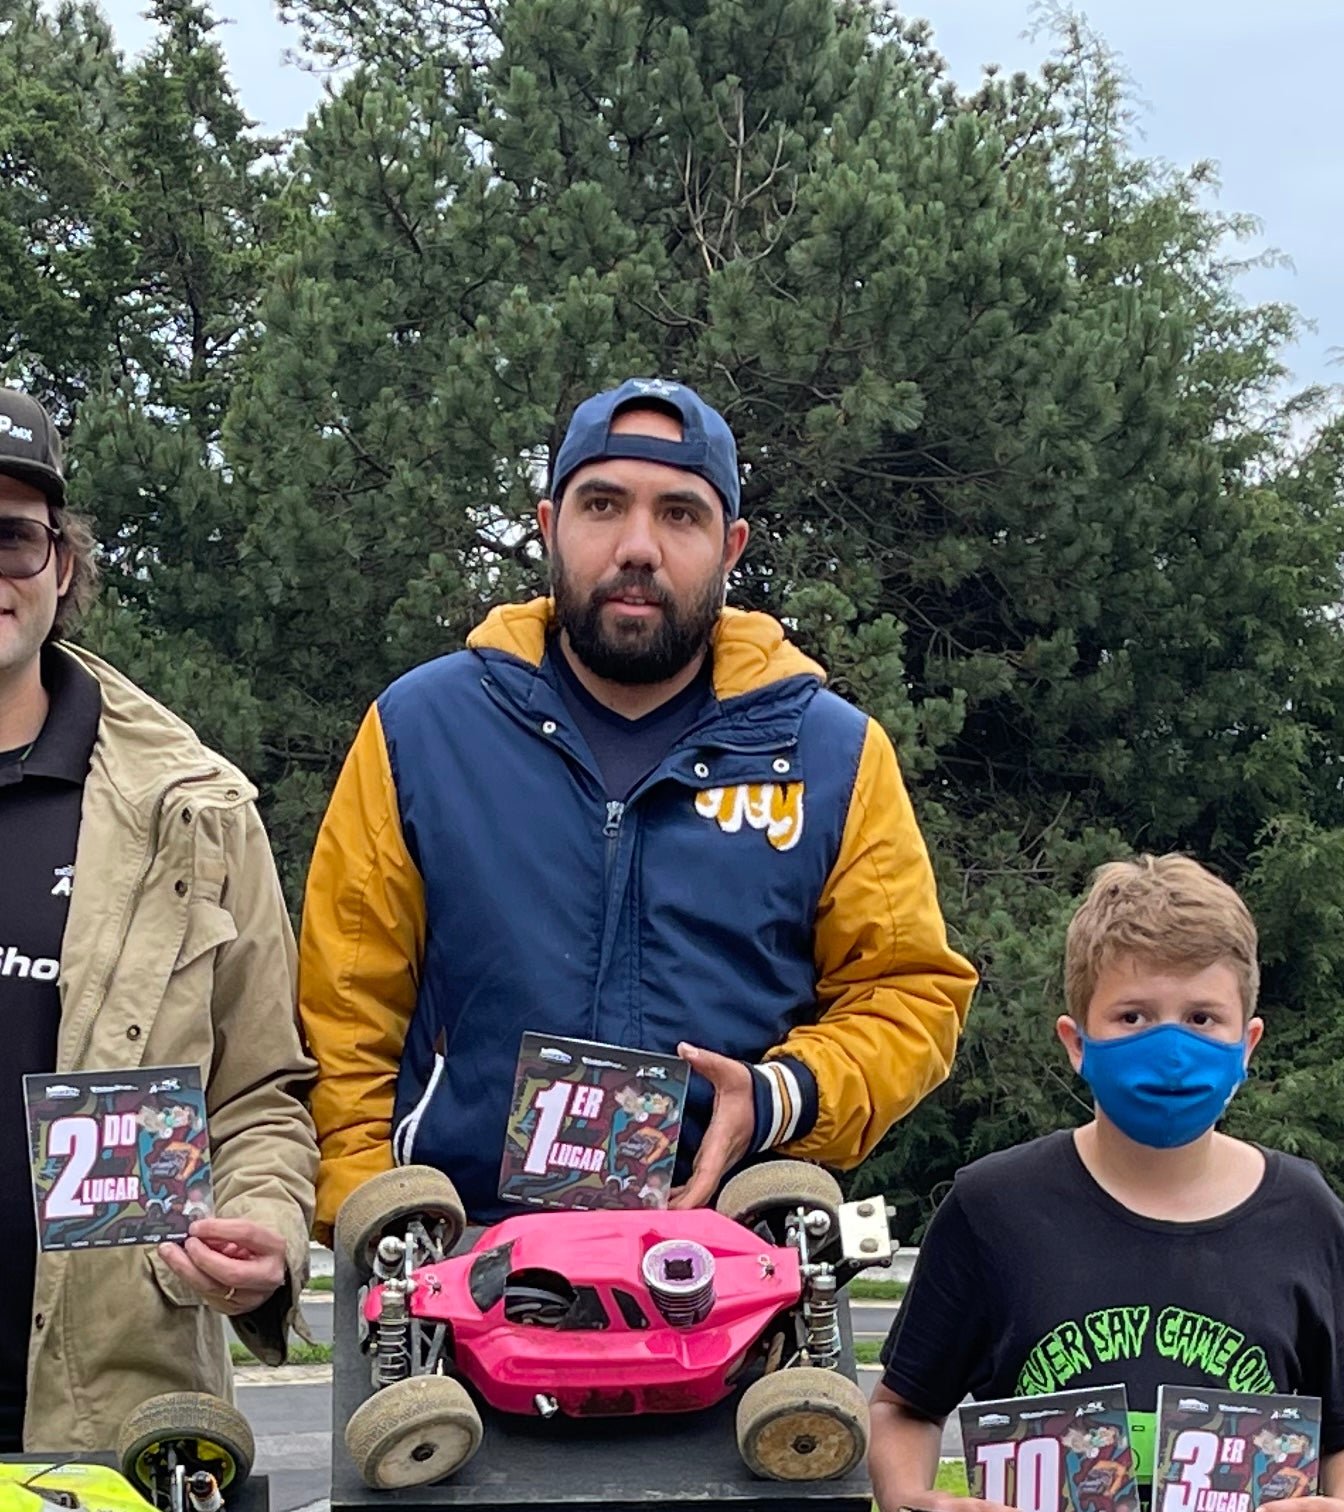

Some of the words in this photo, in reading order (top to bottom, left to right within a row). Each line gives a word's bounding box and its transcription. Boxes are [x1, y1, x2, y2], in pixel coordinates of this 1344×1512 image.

[548, 1142, 607, 1173] LUGAR
[82, 1176, 140, 1204] LUGAR
[1014, 1321, 1092, 1395] EVER
[1085, 1305, 1150, 1363] SAY
[1156, 1305, 1245, 1377] GAME
